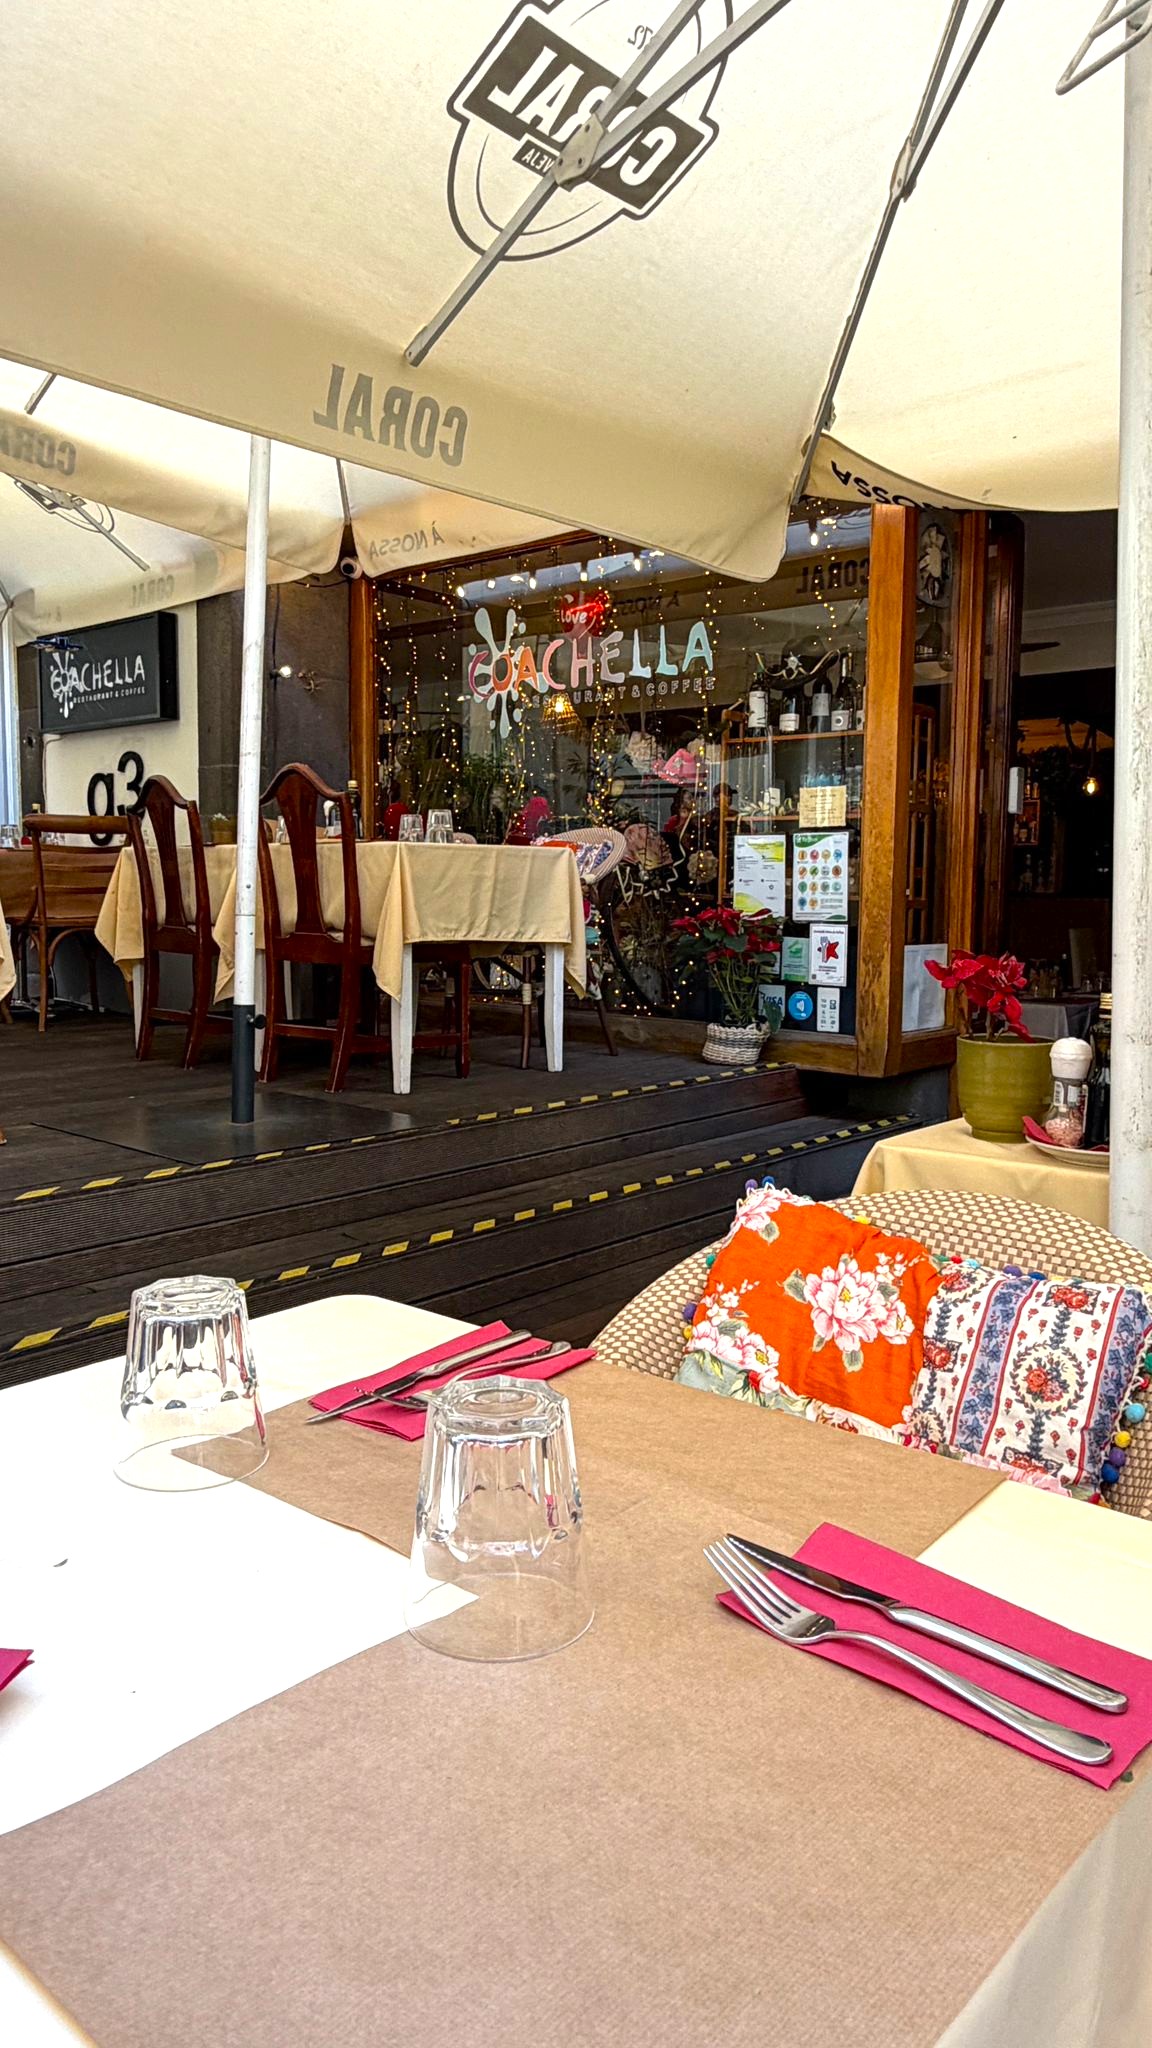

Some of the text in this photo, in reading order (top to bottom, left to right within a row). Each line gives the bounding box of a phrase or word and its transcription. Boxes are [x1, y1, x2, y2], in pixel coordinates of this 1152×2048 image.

[831, 460, 950, 511] OSSA
[51, 655, 145, 694] COACHELLA
[469, 621, 713, 698] COACHELLA
[121, 687, 145, 697] COFFEE
[524, 677, 715, 708] ESURANT & COFFEE
